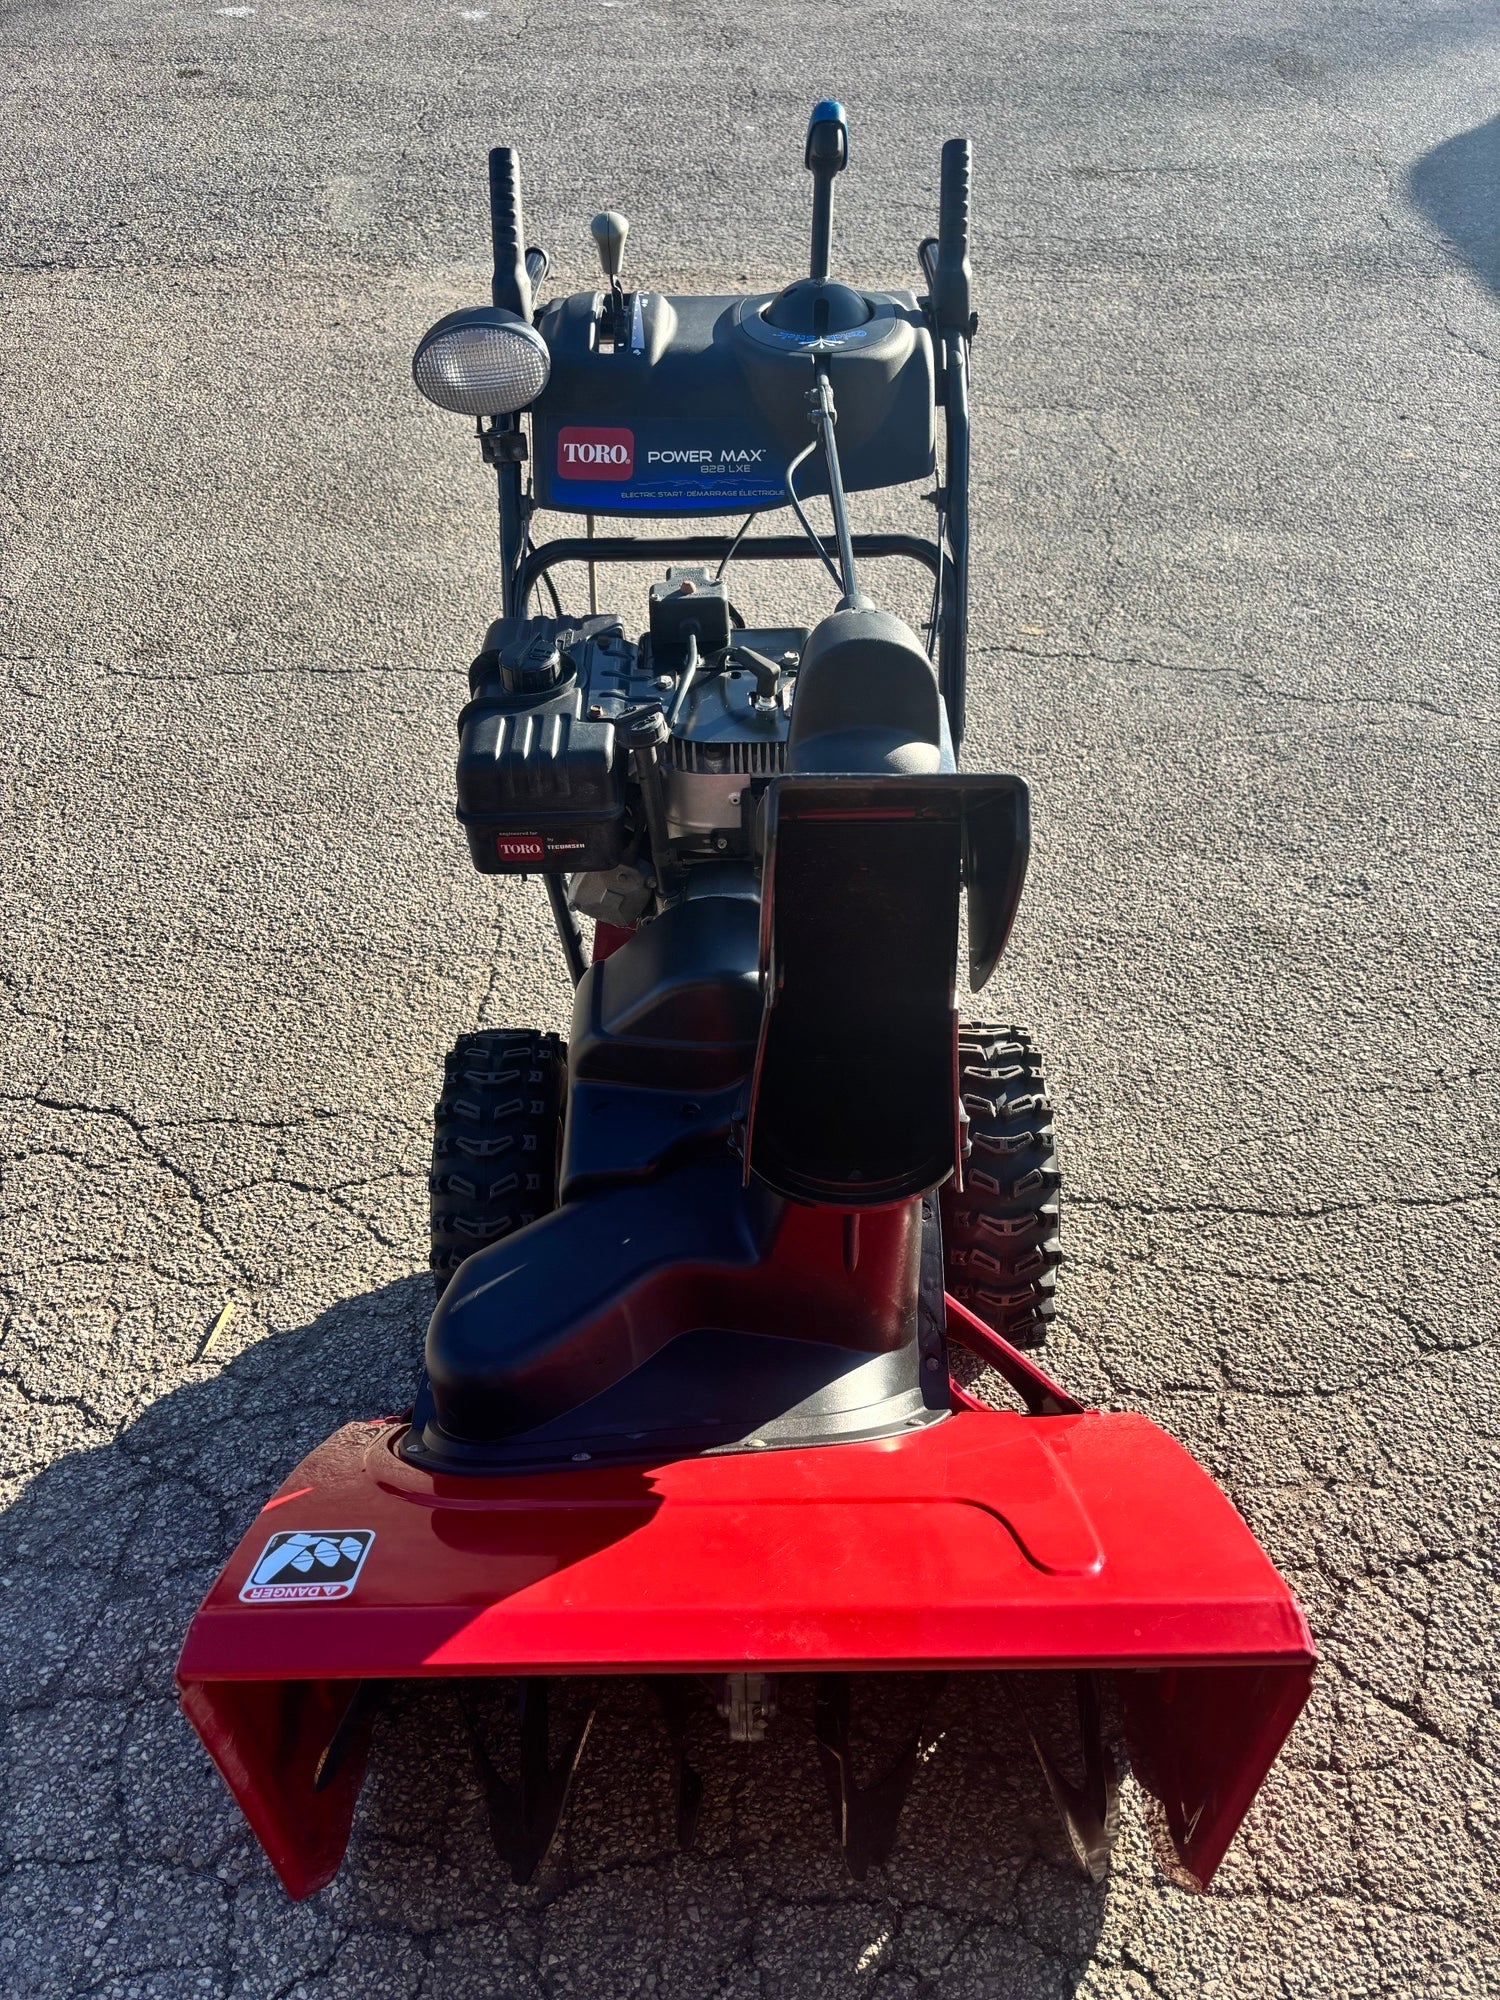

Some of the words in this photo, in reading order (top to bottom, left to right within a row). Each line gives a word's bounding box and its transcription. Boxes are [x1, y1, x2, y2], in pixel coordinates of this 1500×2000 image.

[563, 443, 628, 464] TORO
[647, 450, 713, 464] POWER
[720, 449, 763, 462] MAX
[700, 464, 726, 474] 828
[728, 464, 751, 473] LXE
[500, 843, 541, 854] TORO
[250, 1585, 321, 1599] DANGER
